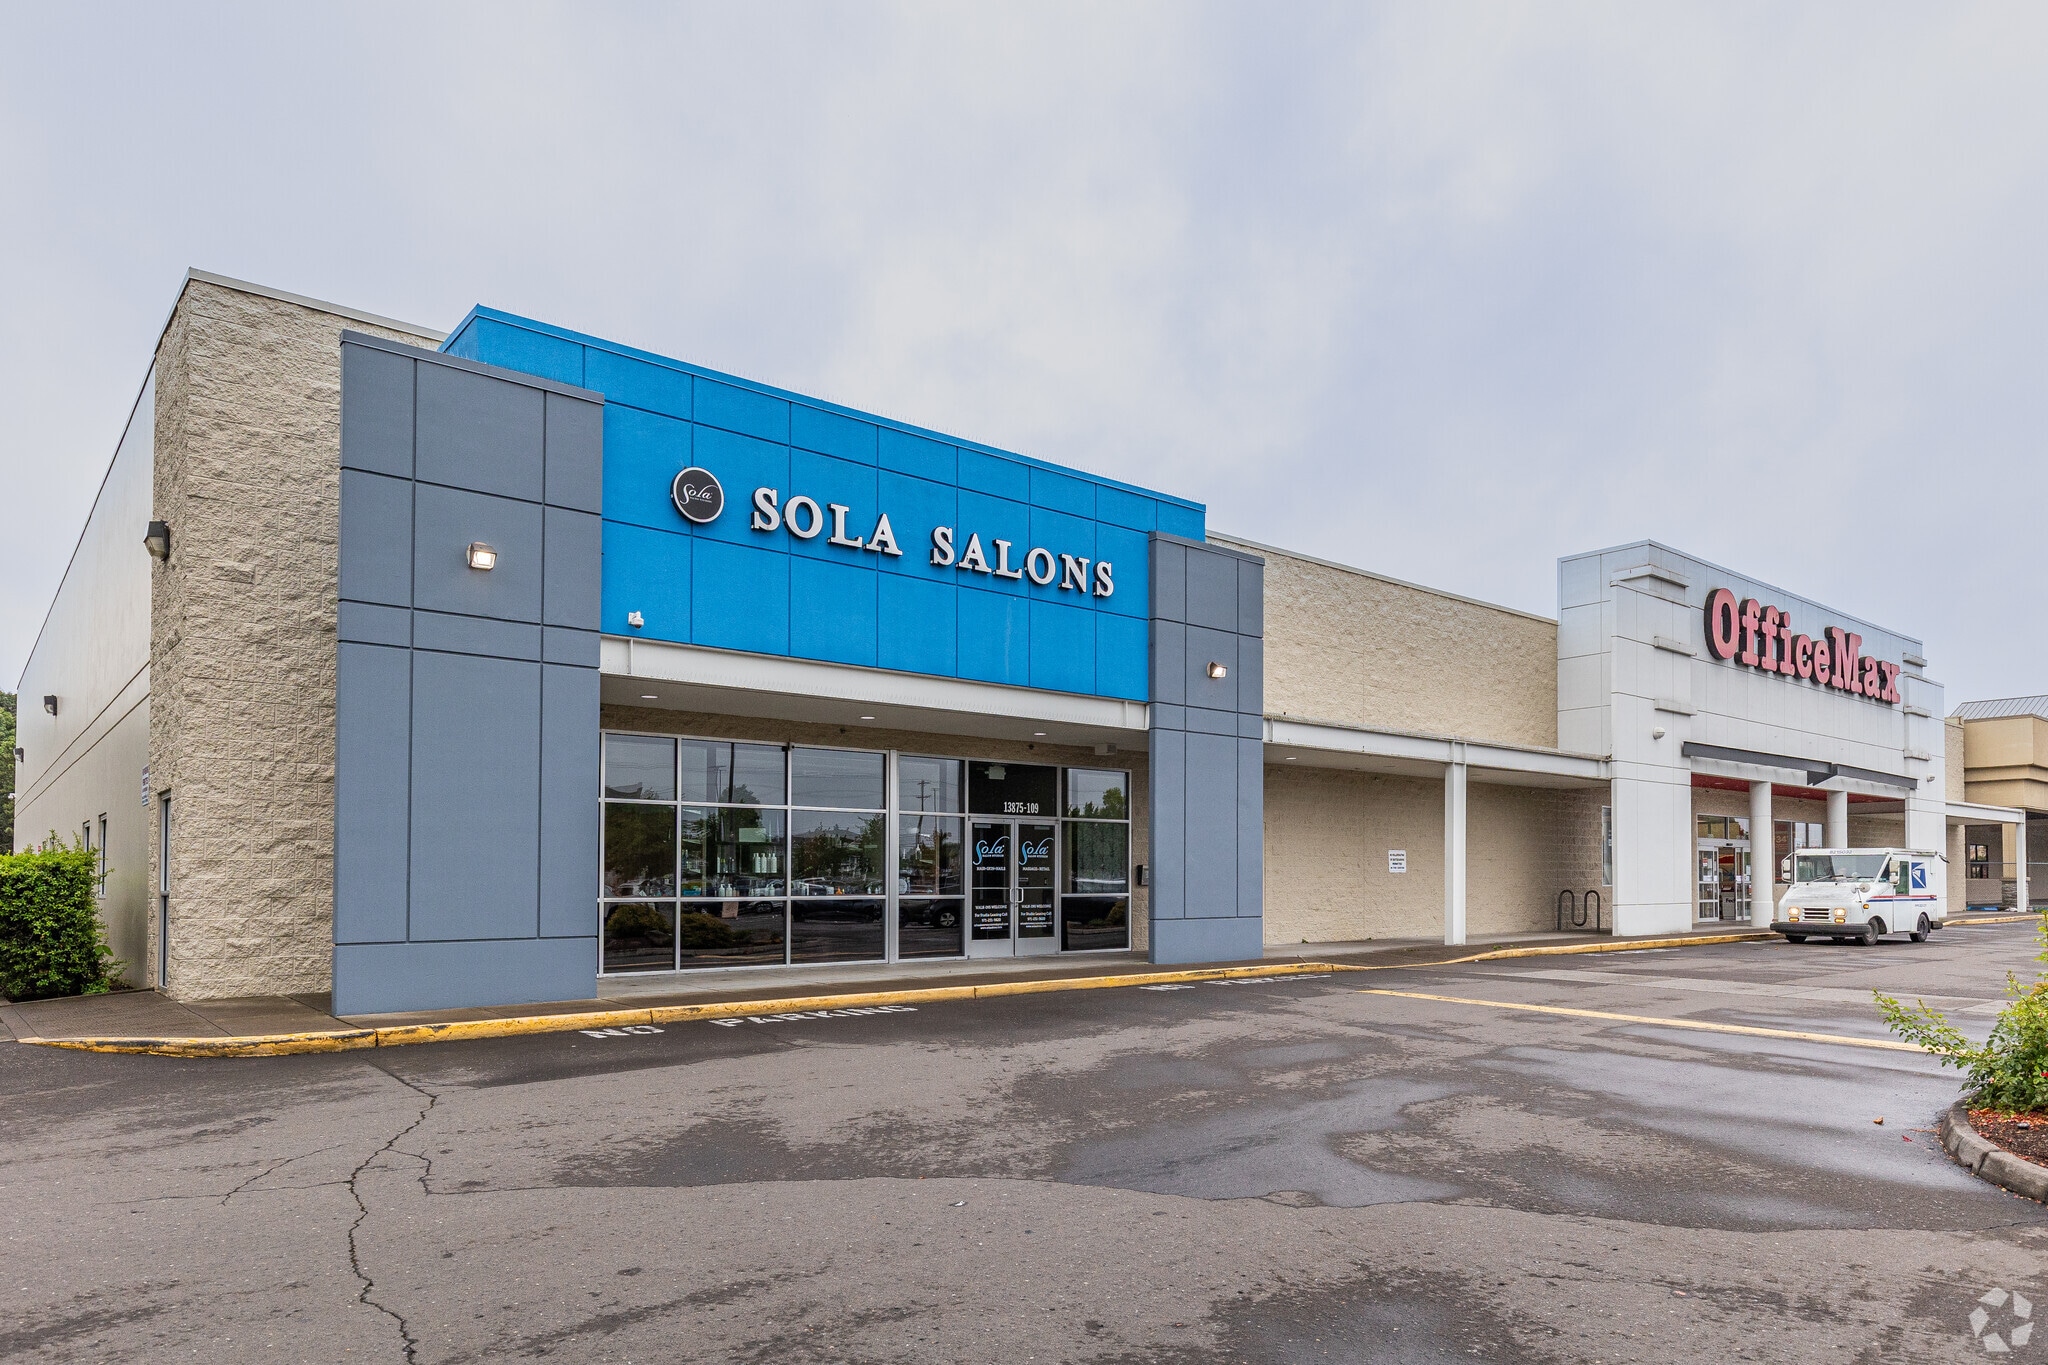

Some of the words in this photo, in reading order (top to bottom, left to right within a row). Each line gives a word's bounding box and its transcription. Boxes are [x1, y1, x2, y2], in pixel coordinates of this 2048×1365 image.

[680, 483, 718, 504] Sola
[751, 487, 902, 556] SOLA
[930, 526, 1115, 598] SALONS
[1704, 587, 1900, 704] OfficeMax
[1003, 801, 1039, 814] 13875-109
[972, 835, 1010, 865] Sola
[1018, 837, 1054, 865] Sola
[578, 1024, 666, 1039] NO
[708, 1005, 919, 1027] PARKING
